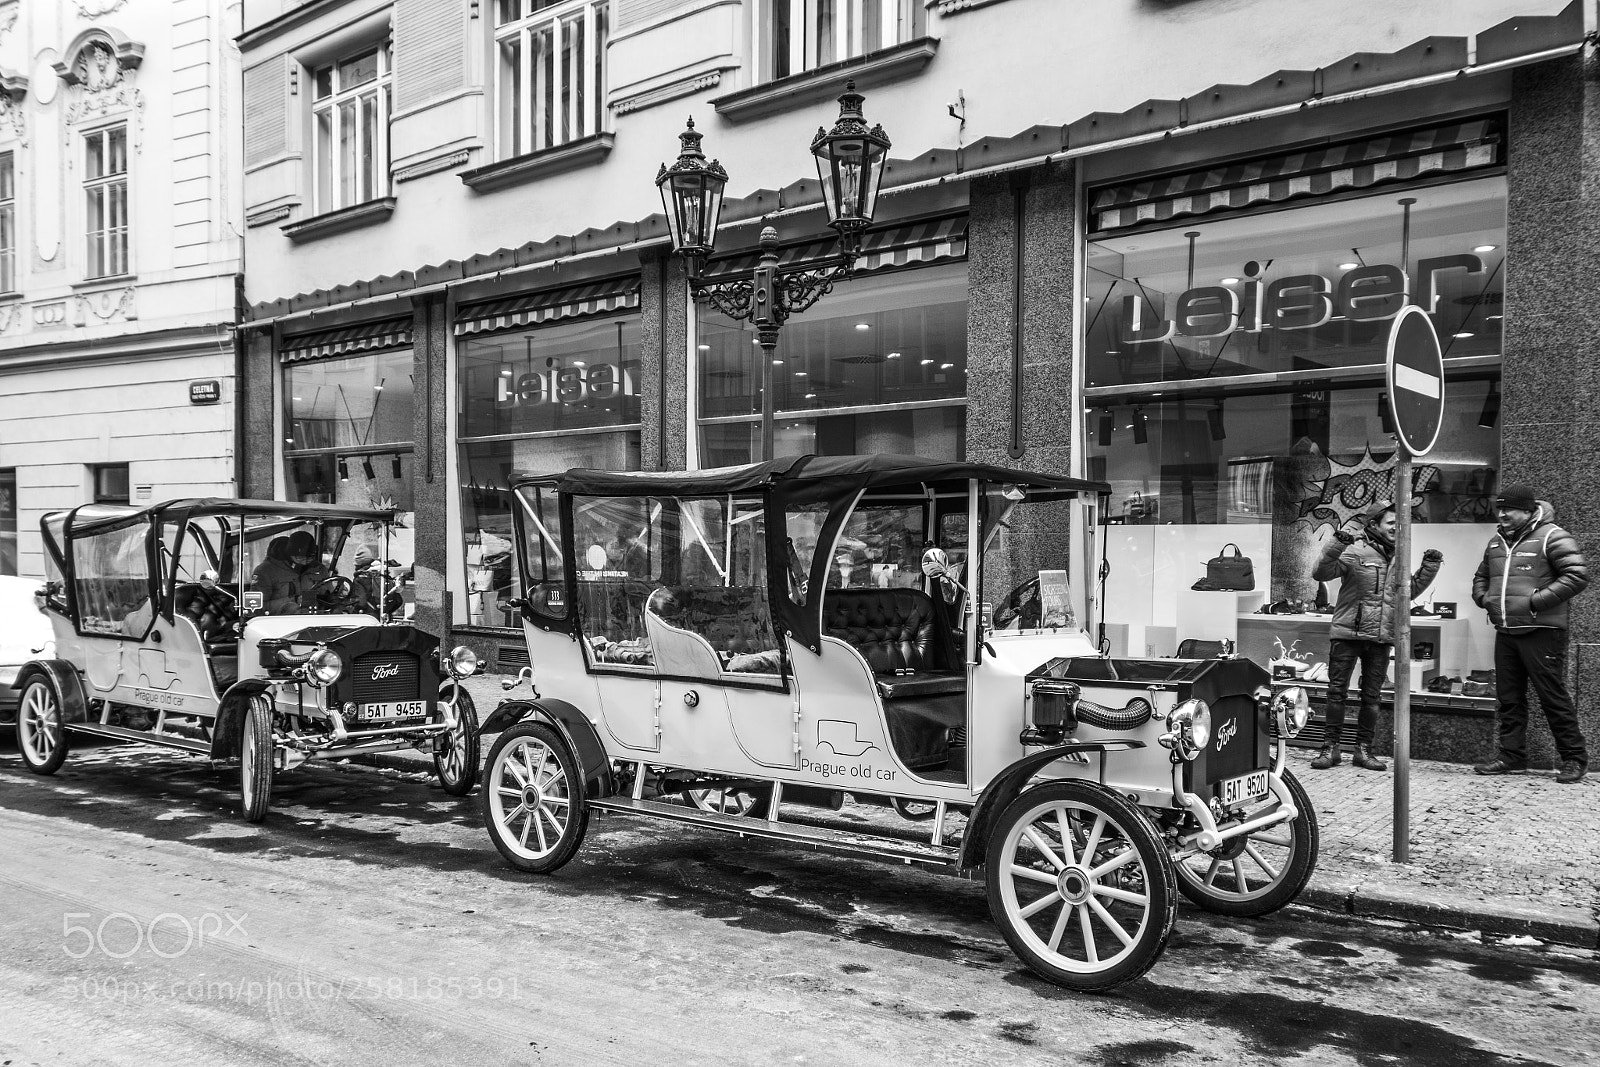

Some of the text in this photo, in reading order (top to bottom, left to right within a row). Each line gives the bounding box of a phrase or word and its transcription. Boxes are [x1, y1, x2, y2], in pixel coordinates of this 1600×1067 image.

[1123, 253, 1484, 344] Leiser
[192, 383, 214, 394] CELETNÁ
[495, 356, 641, 409] Leiser
[371, 663, 399, 681] Ford
[134, 688, 184, 707] Prague old car
[367, 704, 388, 718] 5AT
[396, 702, 422, 716] 9455
[1216, 717, 1238, 752] Ford
[801, 758, 897, 781] Prague old car
[1226, 773, 1265, 802] 5AT 9520
